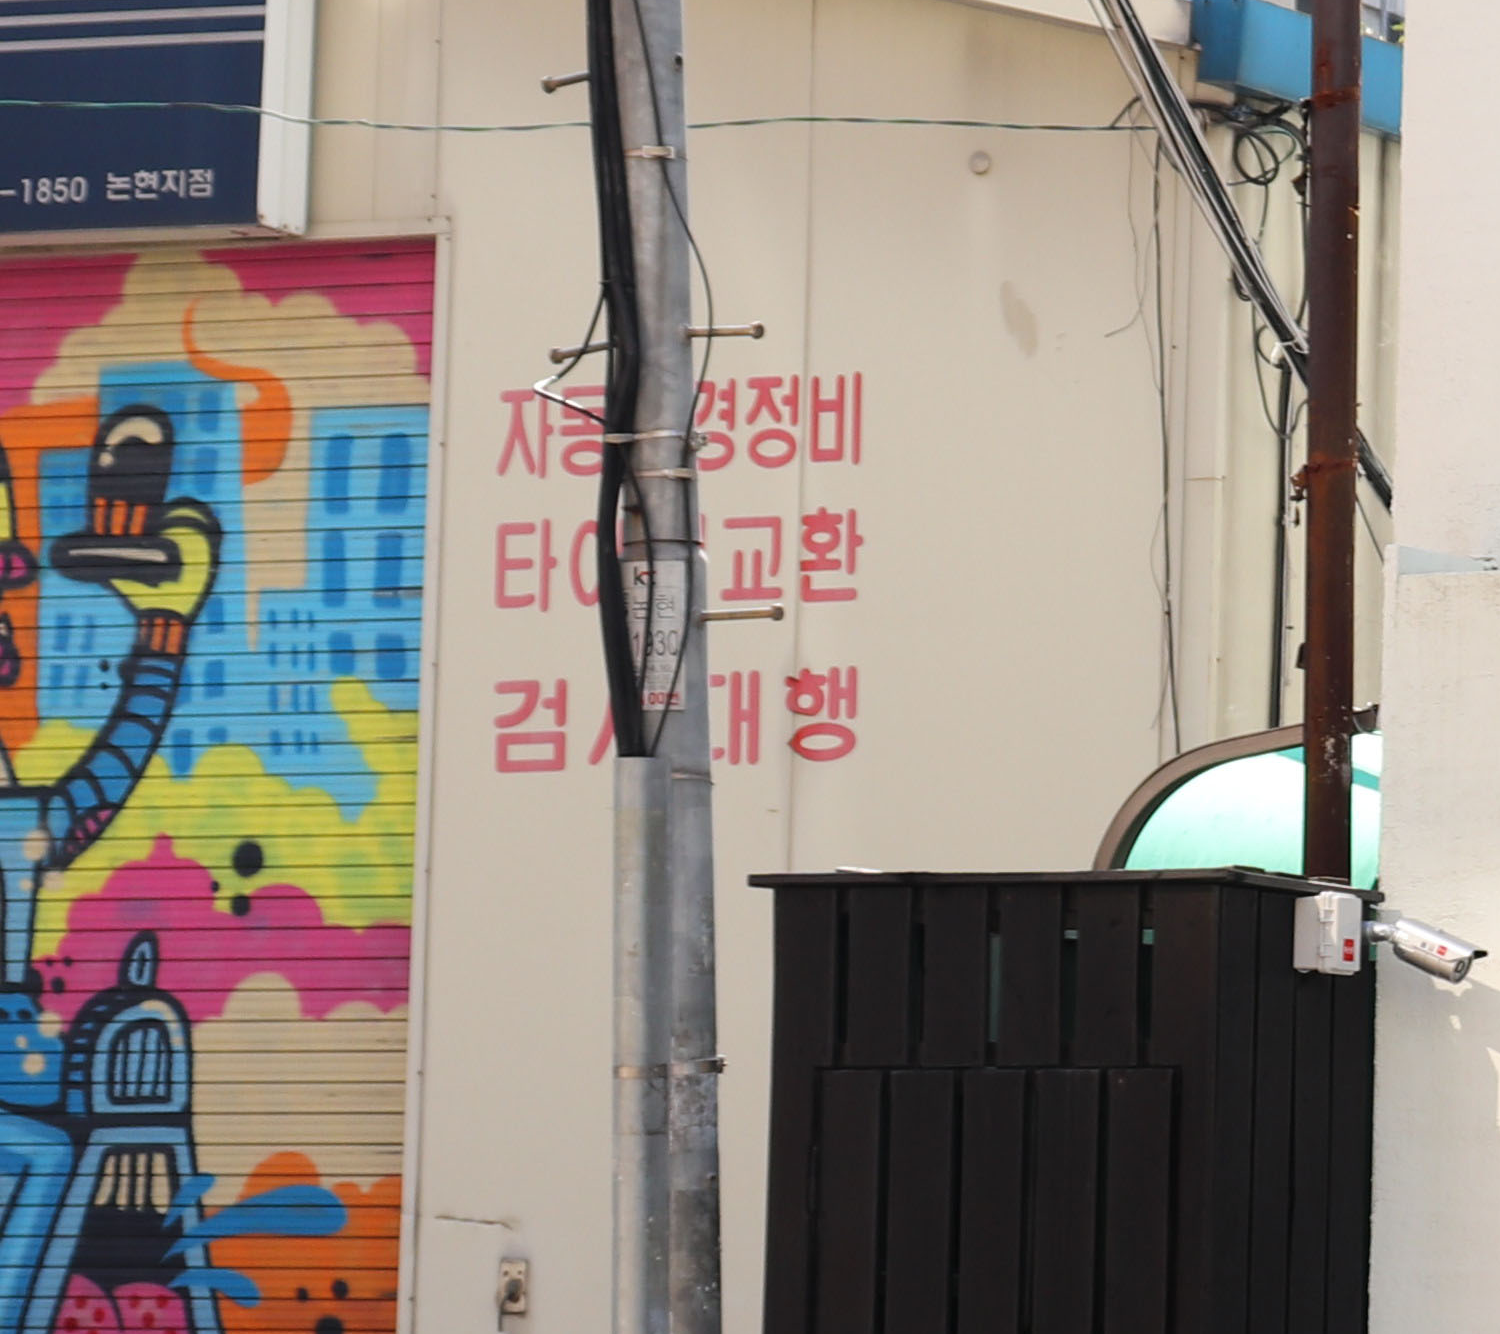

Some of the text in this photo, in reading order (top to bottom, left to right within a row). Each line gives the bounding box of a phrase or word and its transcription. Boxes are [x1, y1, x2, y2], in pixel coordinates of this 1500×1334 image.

[106, 168, 215, 202] 논현지점
[497, 372, 863, 479] 자동경정비
[495, 507, 864, 612] 타이교환
